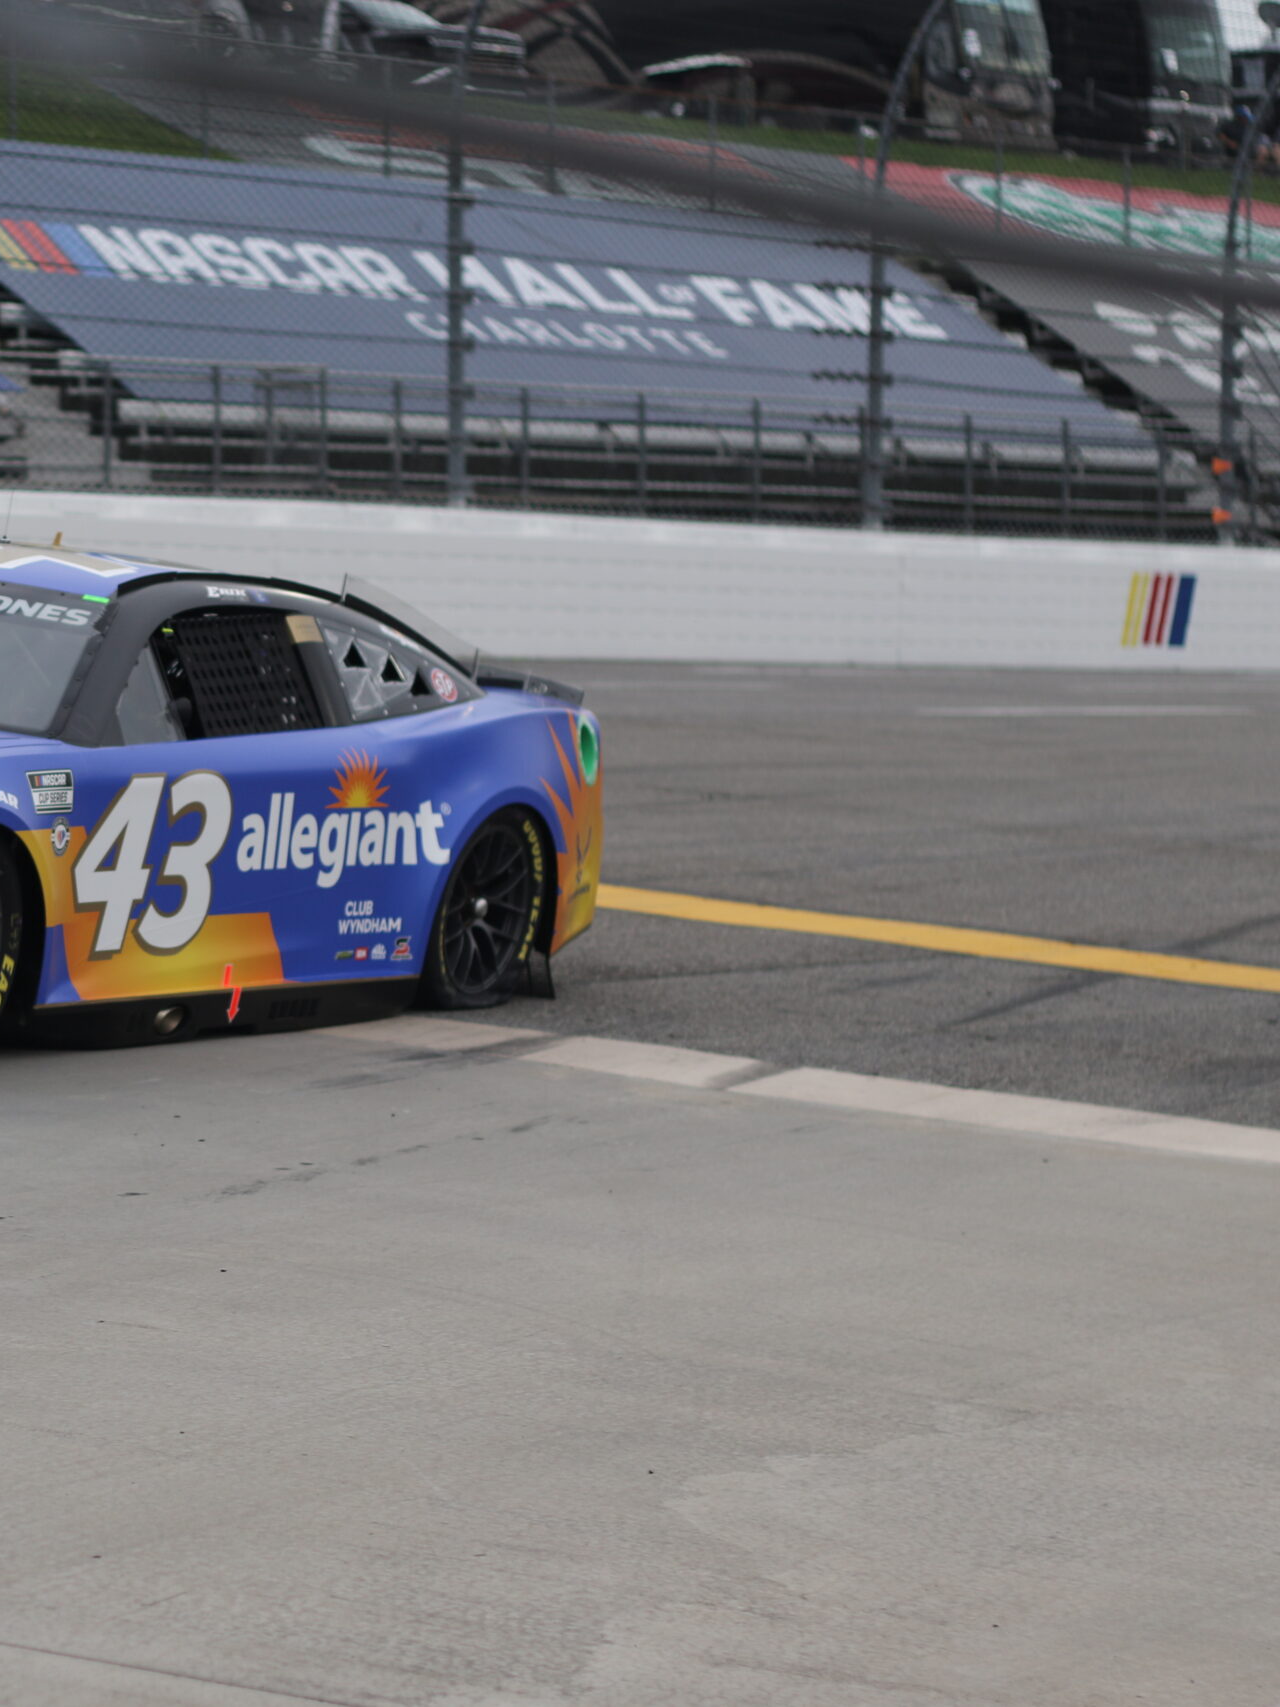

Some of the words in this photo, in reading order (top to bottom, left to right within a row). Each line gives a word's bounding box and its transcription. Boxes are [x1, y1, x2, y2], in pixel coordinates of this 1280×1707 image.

[77, 223, 430, 302] NASCAR
[412, 250, 696, 320] HALL
[689, 274, 948, 340] FAME
[405, 312, 729, 358] CHARLOTTE
[42, 774, 67, 786] NASCAR
[38, 792, 50, 804] CUP
[50, 791, 68, 804] SERIES
[237, 792, 450, 888] allegiant
[72, 770, 233, 959] 43
[345, 900, 374, 917] CLUB
[338, 917, 402, 934] WYNDHAM
